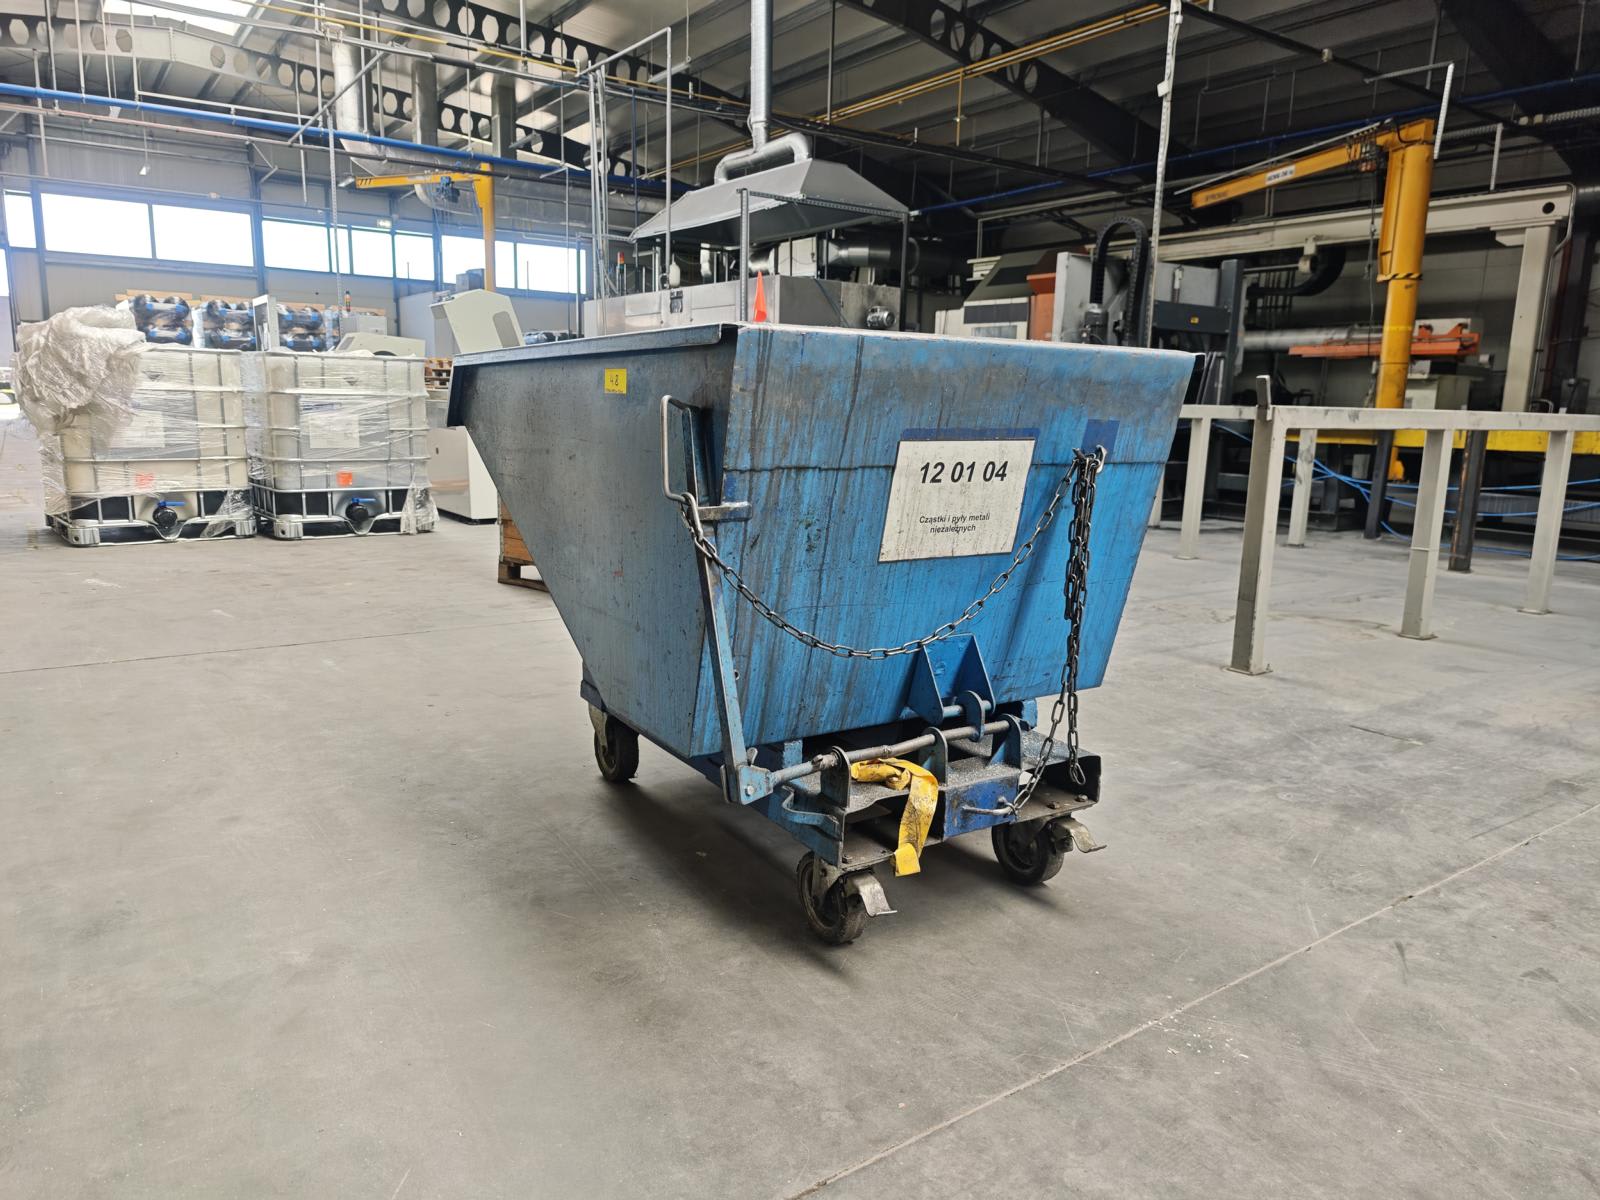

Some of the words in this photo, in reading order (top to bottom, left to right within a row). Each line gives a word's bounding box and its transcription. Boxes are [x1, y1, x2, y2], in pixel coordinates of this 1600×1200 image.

[920, 462, 945, 484] 12
[950, 461, 976, 483] 01
[982, 460, 1009, 482] 04
[919, 515, 946, 525] Cząstki
[968, 512, 990, 521] metali
